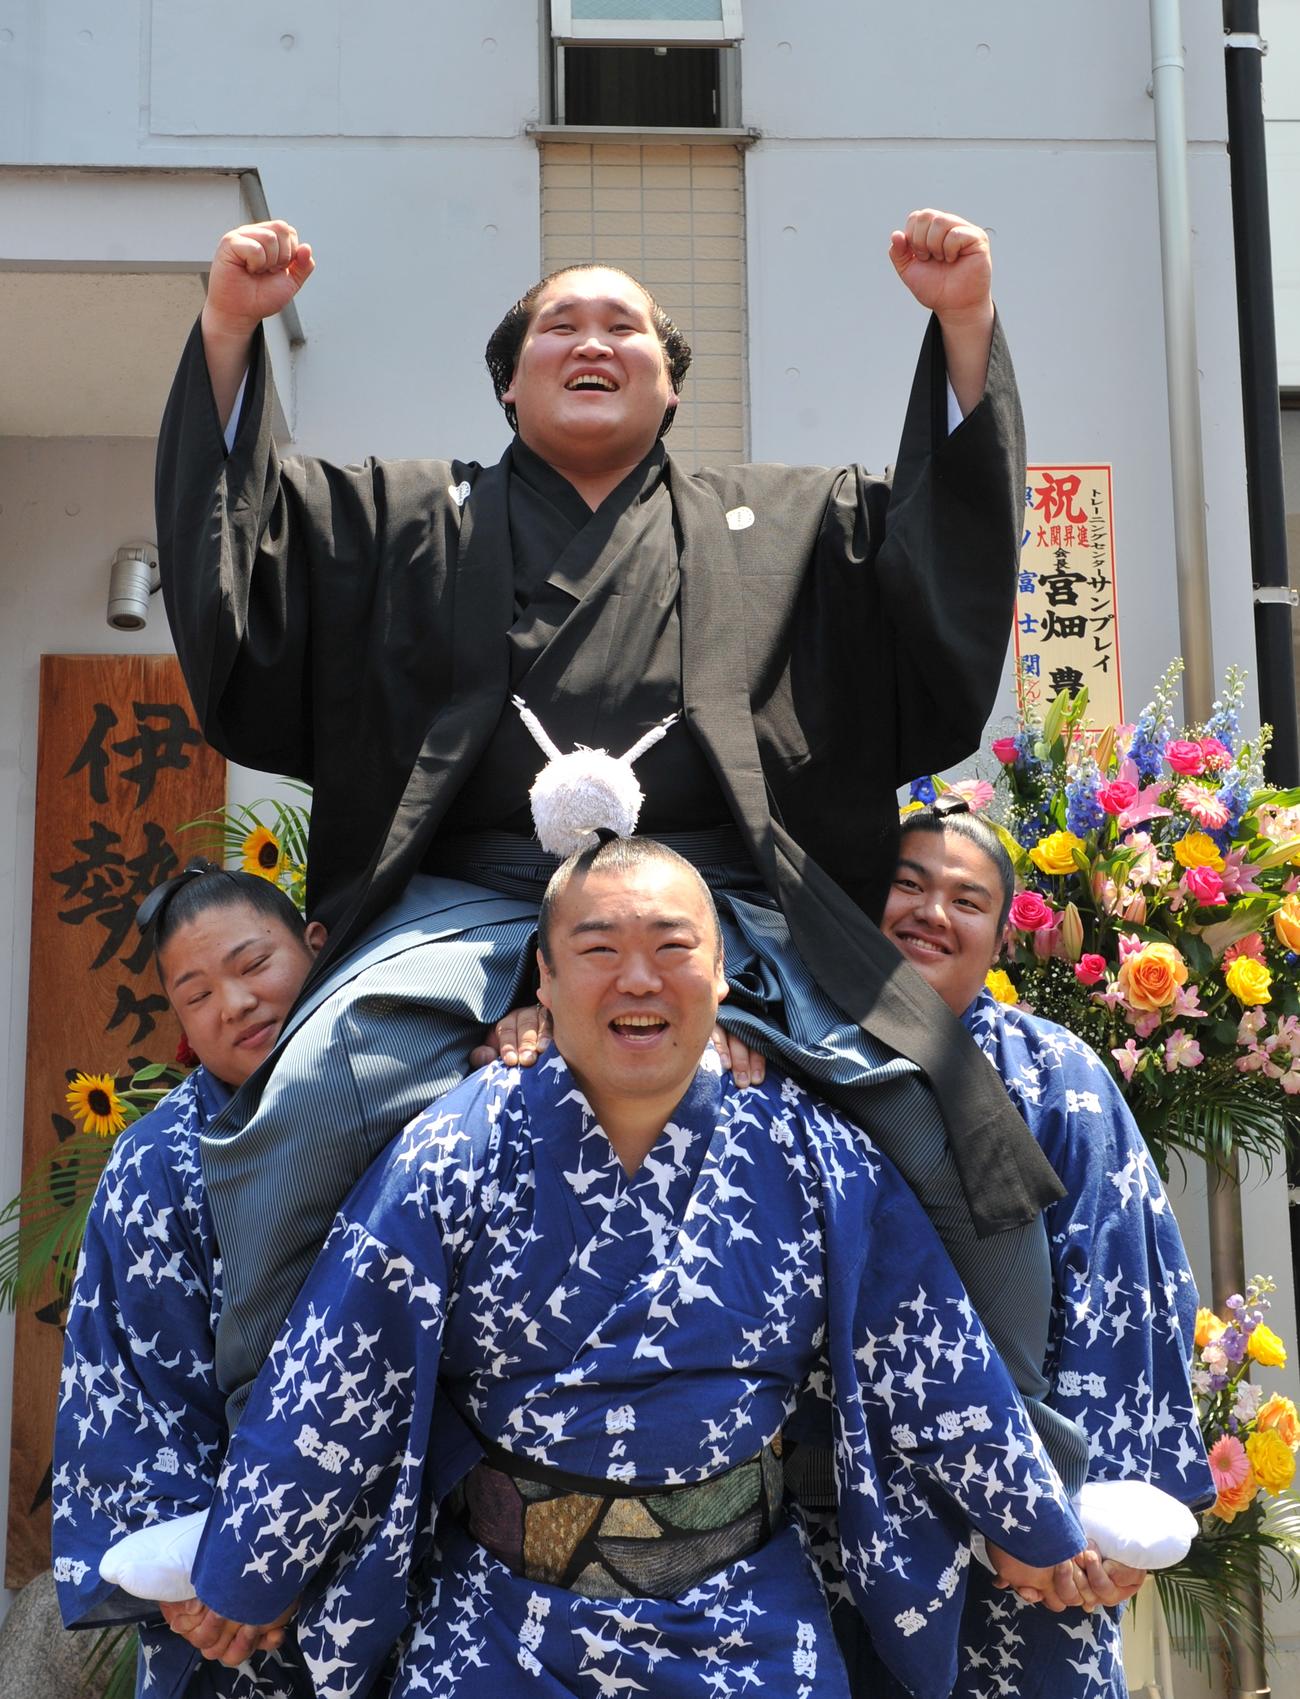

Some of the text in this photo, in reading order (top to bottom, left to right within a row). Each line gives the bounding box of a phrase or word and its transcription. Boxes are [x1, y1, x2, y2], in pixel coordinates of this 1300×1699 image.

[1033, 472, 1088, 524] 祝
[1036, 525, 1090, 548] 大関昇進
